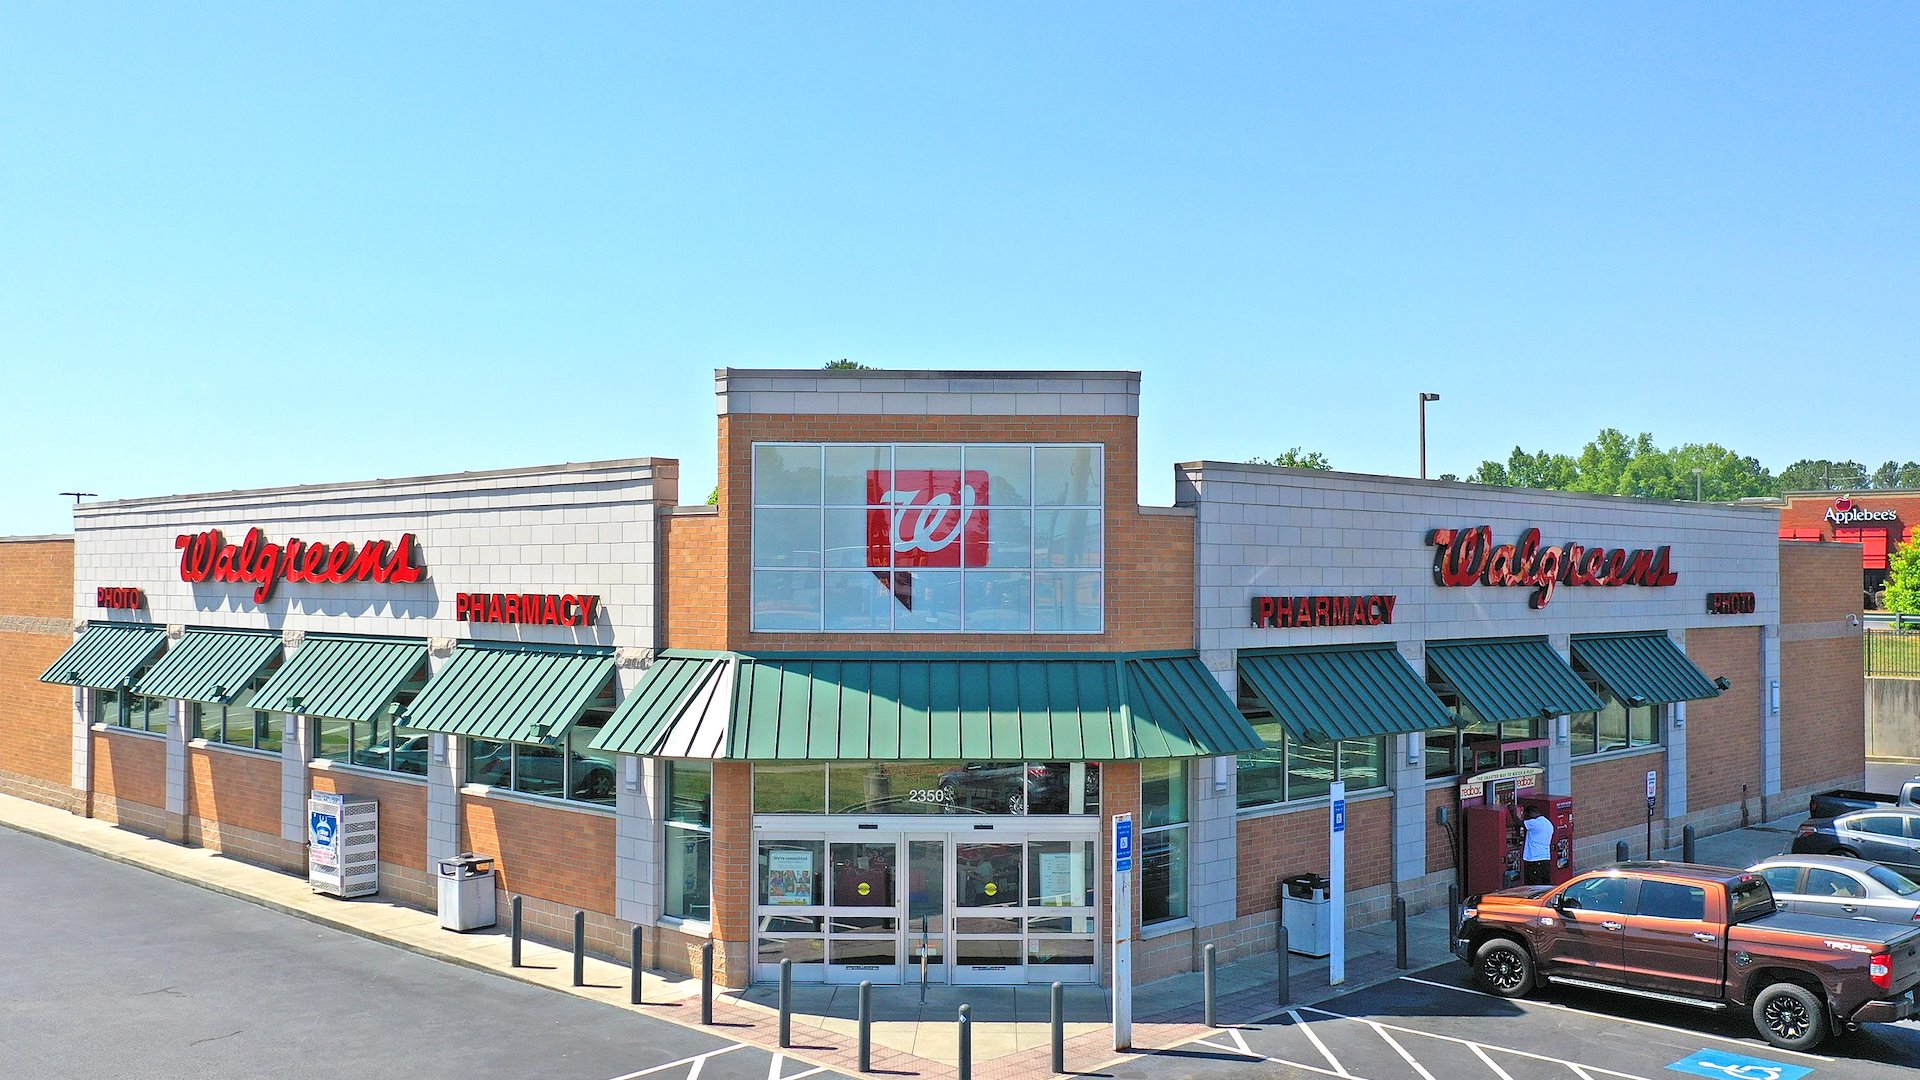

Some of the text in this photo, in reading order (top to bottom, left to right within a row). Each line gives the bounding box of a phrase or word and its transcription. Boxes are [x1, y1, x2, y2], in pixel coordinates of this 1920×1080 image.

[1823, 507, 1897, 524] Applebee's
[175, 526, 425, 604] Walgreens
[1429, 524, 1678, 609] Walgreens
[97, 587, 144, 610] PHOTO
[456, 592, 597, 627] PHARMACY
[1255, 594, 1397, 629] PHARMACY
[1711, 592, 1756, 614] PHOTO
[909, 789, 944, 803] 2350
